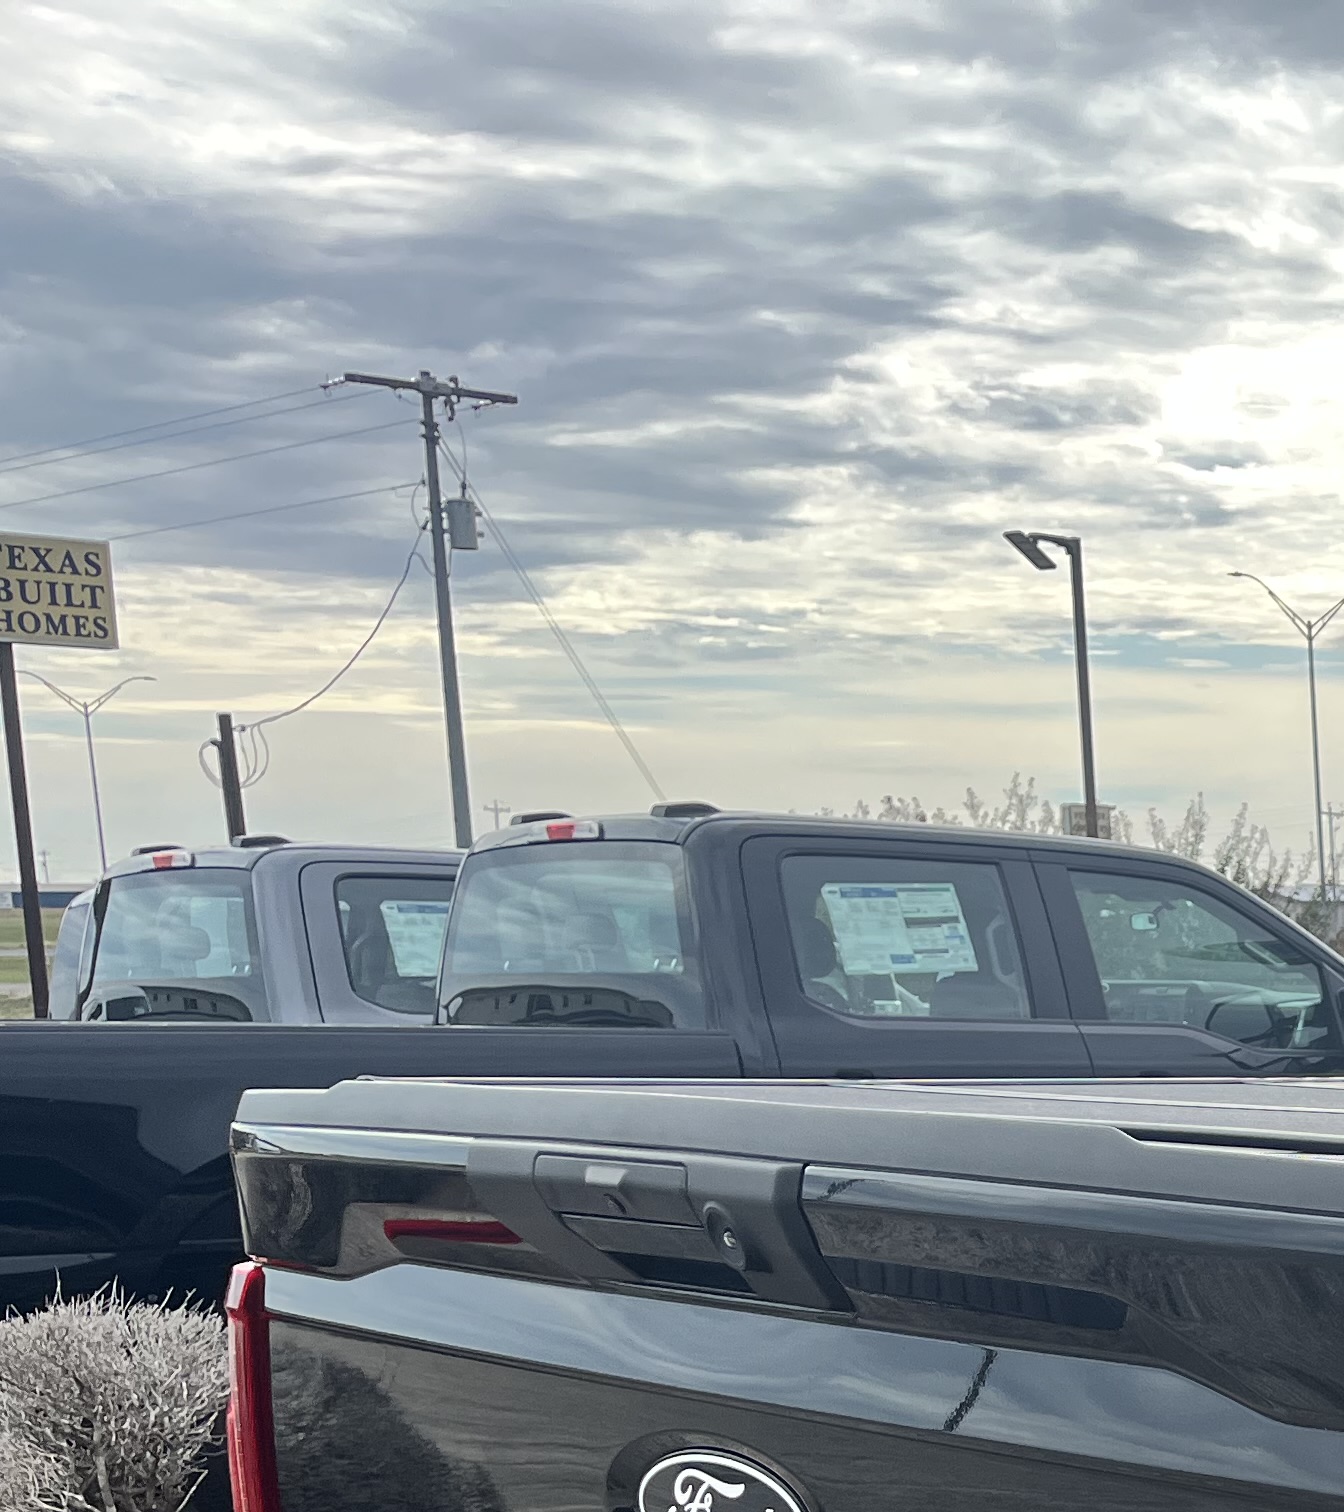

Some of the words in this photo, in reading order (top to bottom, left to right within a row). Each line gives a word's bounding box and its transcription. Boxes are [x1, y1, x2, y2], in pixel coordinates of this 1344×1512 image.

[0, 543, 102, 577] EXAS
[0, 577, 105, 609] BUILT
[0, 608, 109, 639] HOMES
